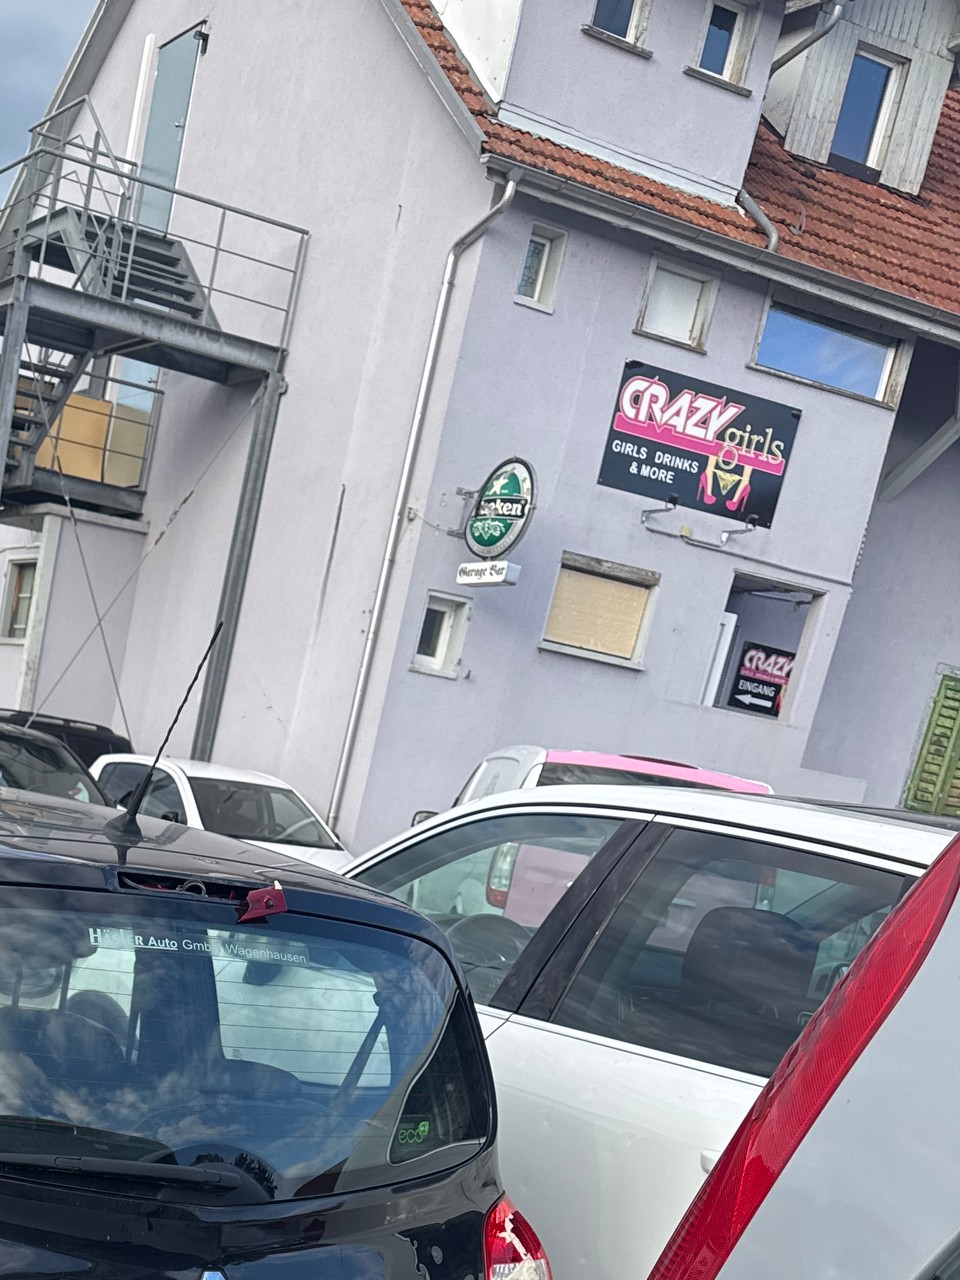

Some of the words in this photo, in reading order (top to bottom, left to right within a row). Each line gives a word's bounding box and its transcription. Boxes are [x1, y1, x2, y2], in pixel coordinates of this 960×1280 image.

[619, 375, 746, 444] CRAZY
[717, 423, 785, 471] girls
[611, 439, 648, 461] GIRLS
[654, 450, 700, 475] DRINKS
[640, 464, 676, 484] MORE
[743, 648, 796, 678] CRAZY
[737, 679, 776, 698] EINGANG
[147, 935, 178, 949] Auto
[225, 943, 307, 965] Wagenhausen
